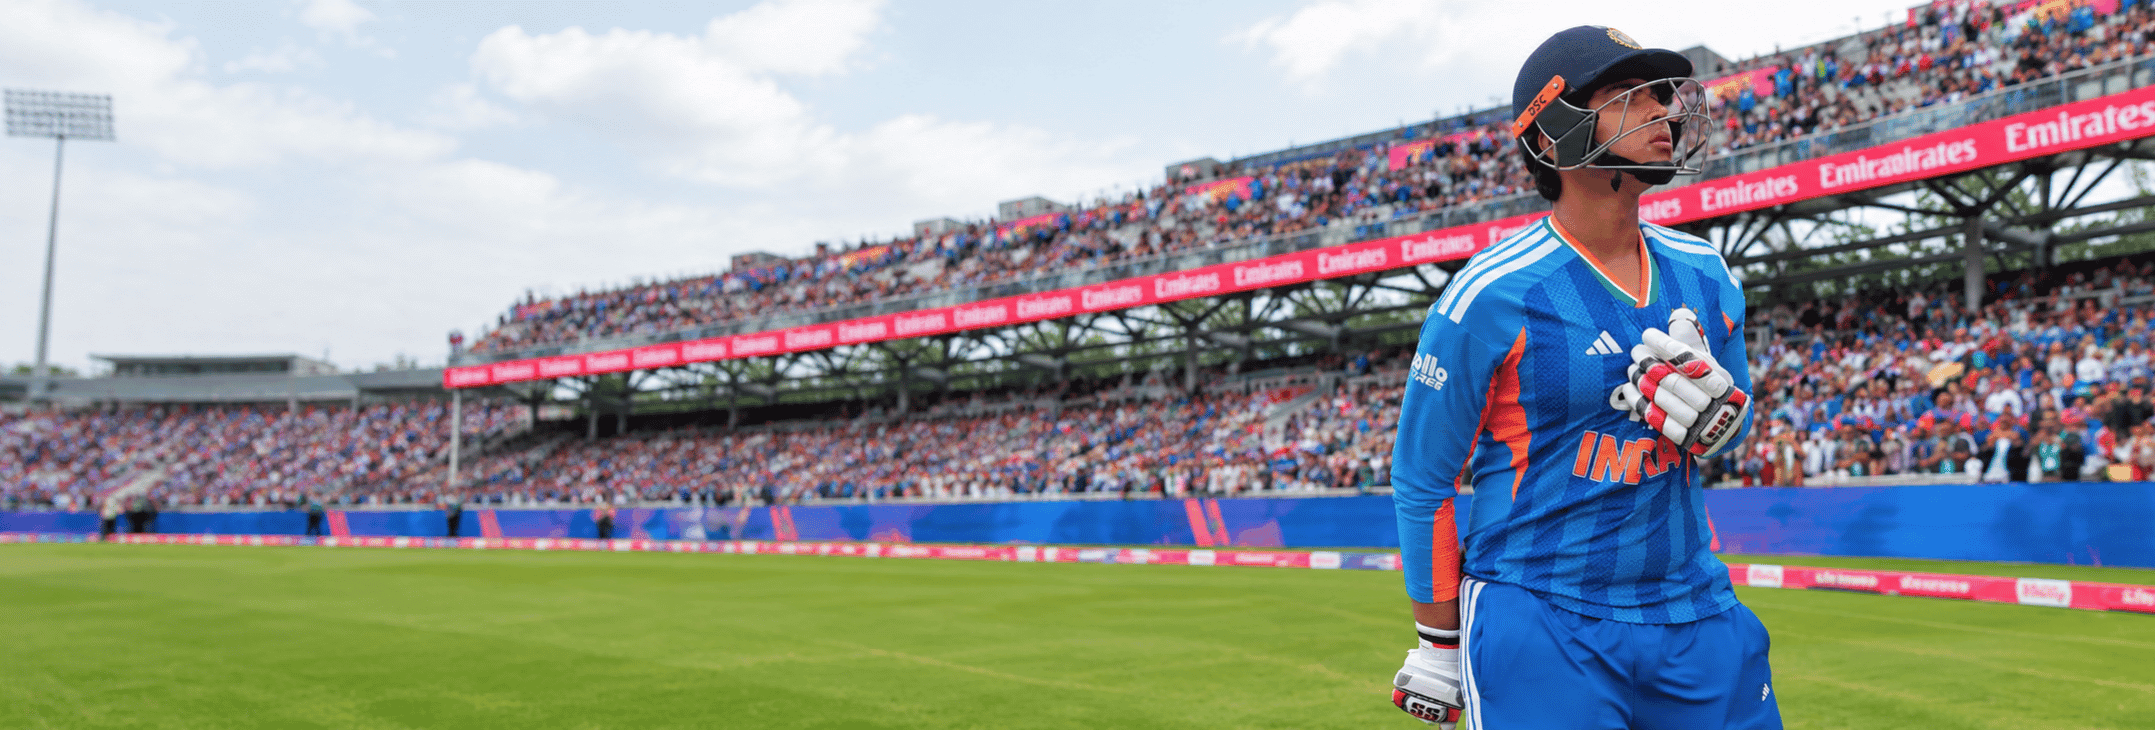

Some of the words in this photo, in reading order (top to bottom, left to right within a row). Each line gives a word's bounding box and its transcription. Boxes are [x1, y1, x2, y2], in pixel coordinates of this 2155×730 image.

[2004, 100, 2155, 153] Emirates
[1638, 197, 1682, 221] ates
[1700, 175, 1799, 212] Emirates
